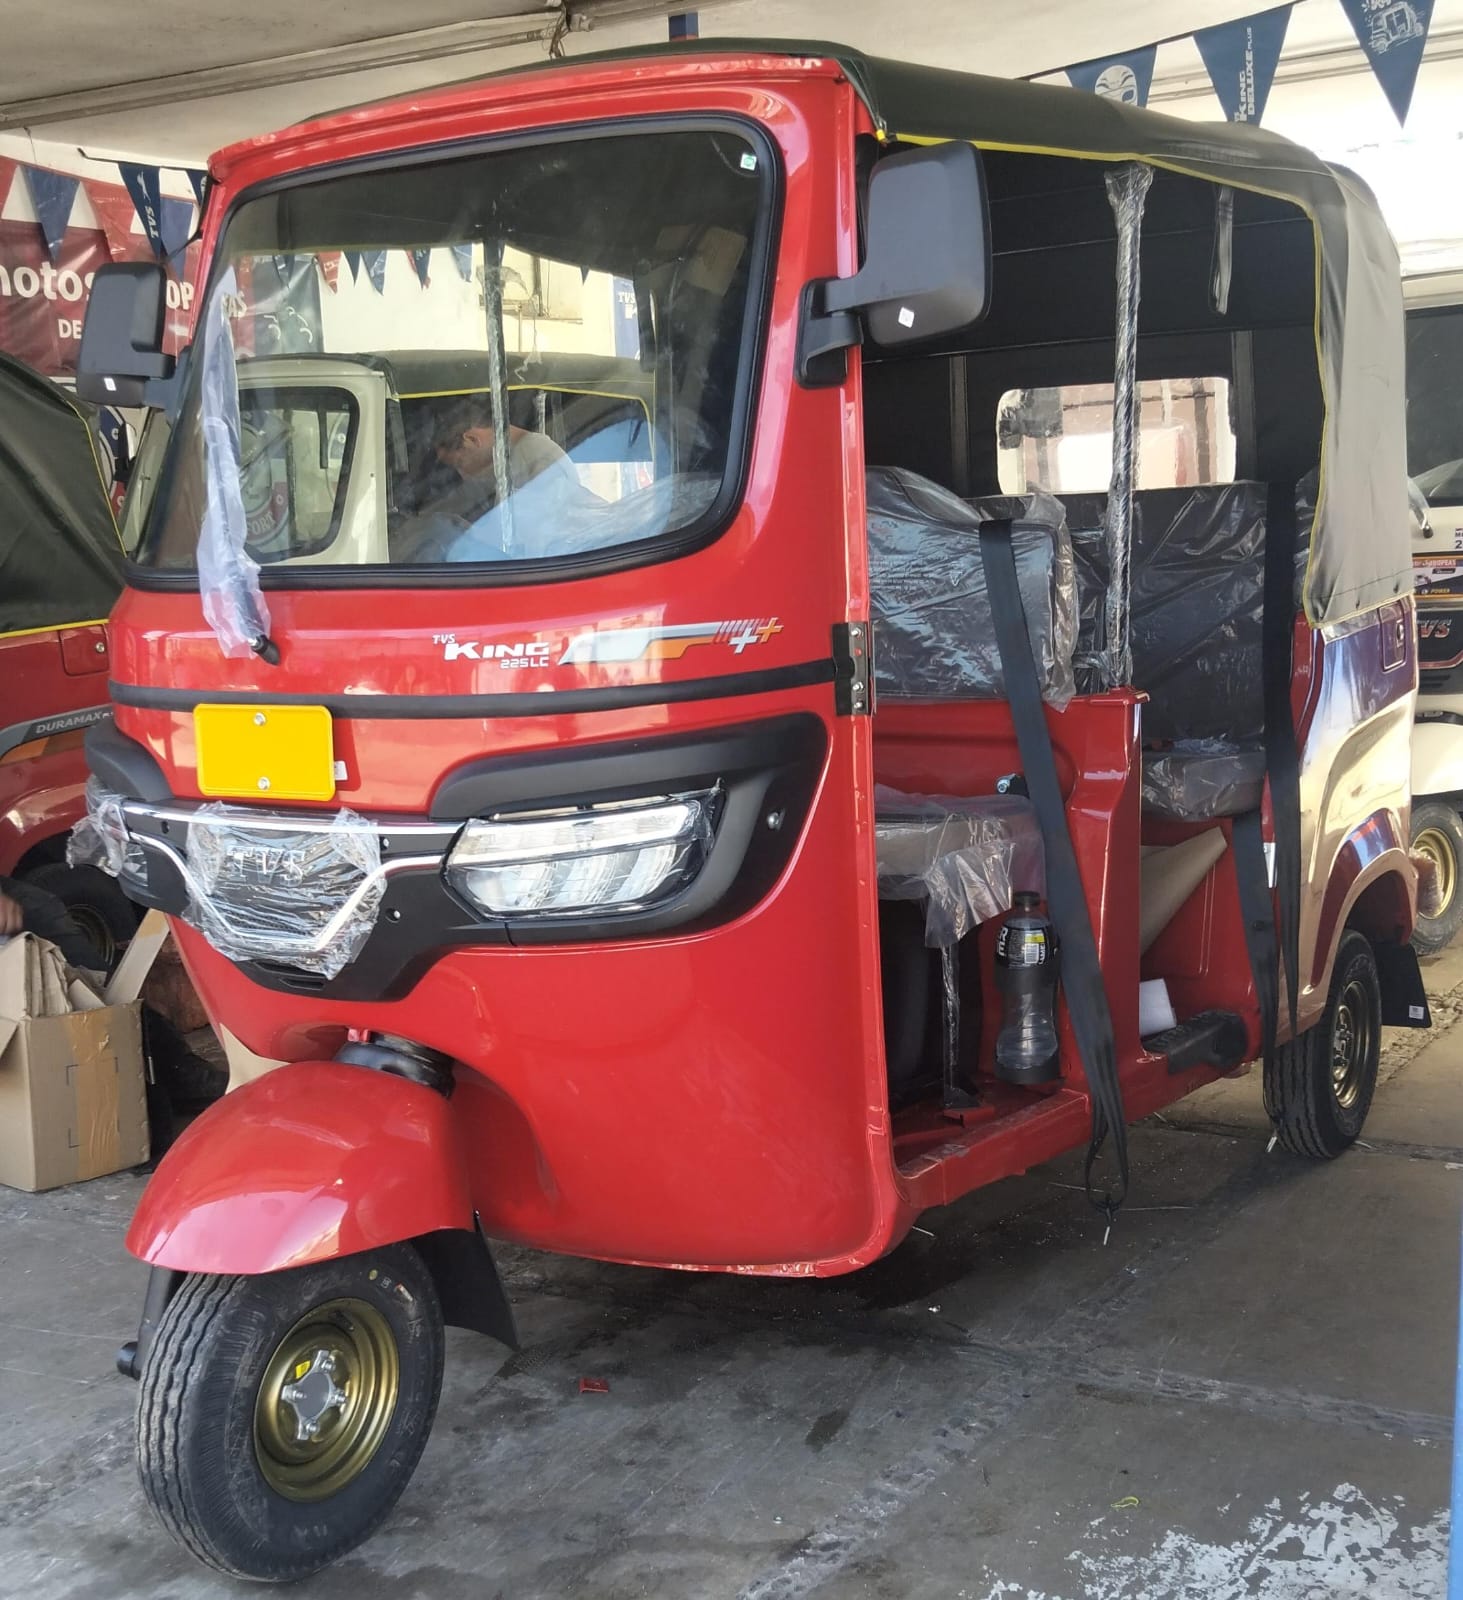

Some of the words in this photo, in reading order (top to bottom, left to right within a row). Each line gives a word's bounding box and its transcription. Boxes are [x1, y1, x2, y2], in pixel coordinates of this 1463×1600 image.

[1245, 50, 1255, 115] DELUXE
[1239, 70, 1247, 122] KING
[144, 205, 160, 239] TVS
[432, 634, 455, 645] TVS
[1420, 622, 1450, 639] VS
[444, 641, 549, 660] KING
[500, 656, 549, 669] 225LC
[35, 711, 103, 734] DURAMAX
[226, 846, 306, 887] TVS
